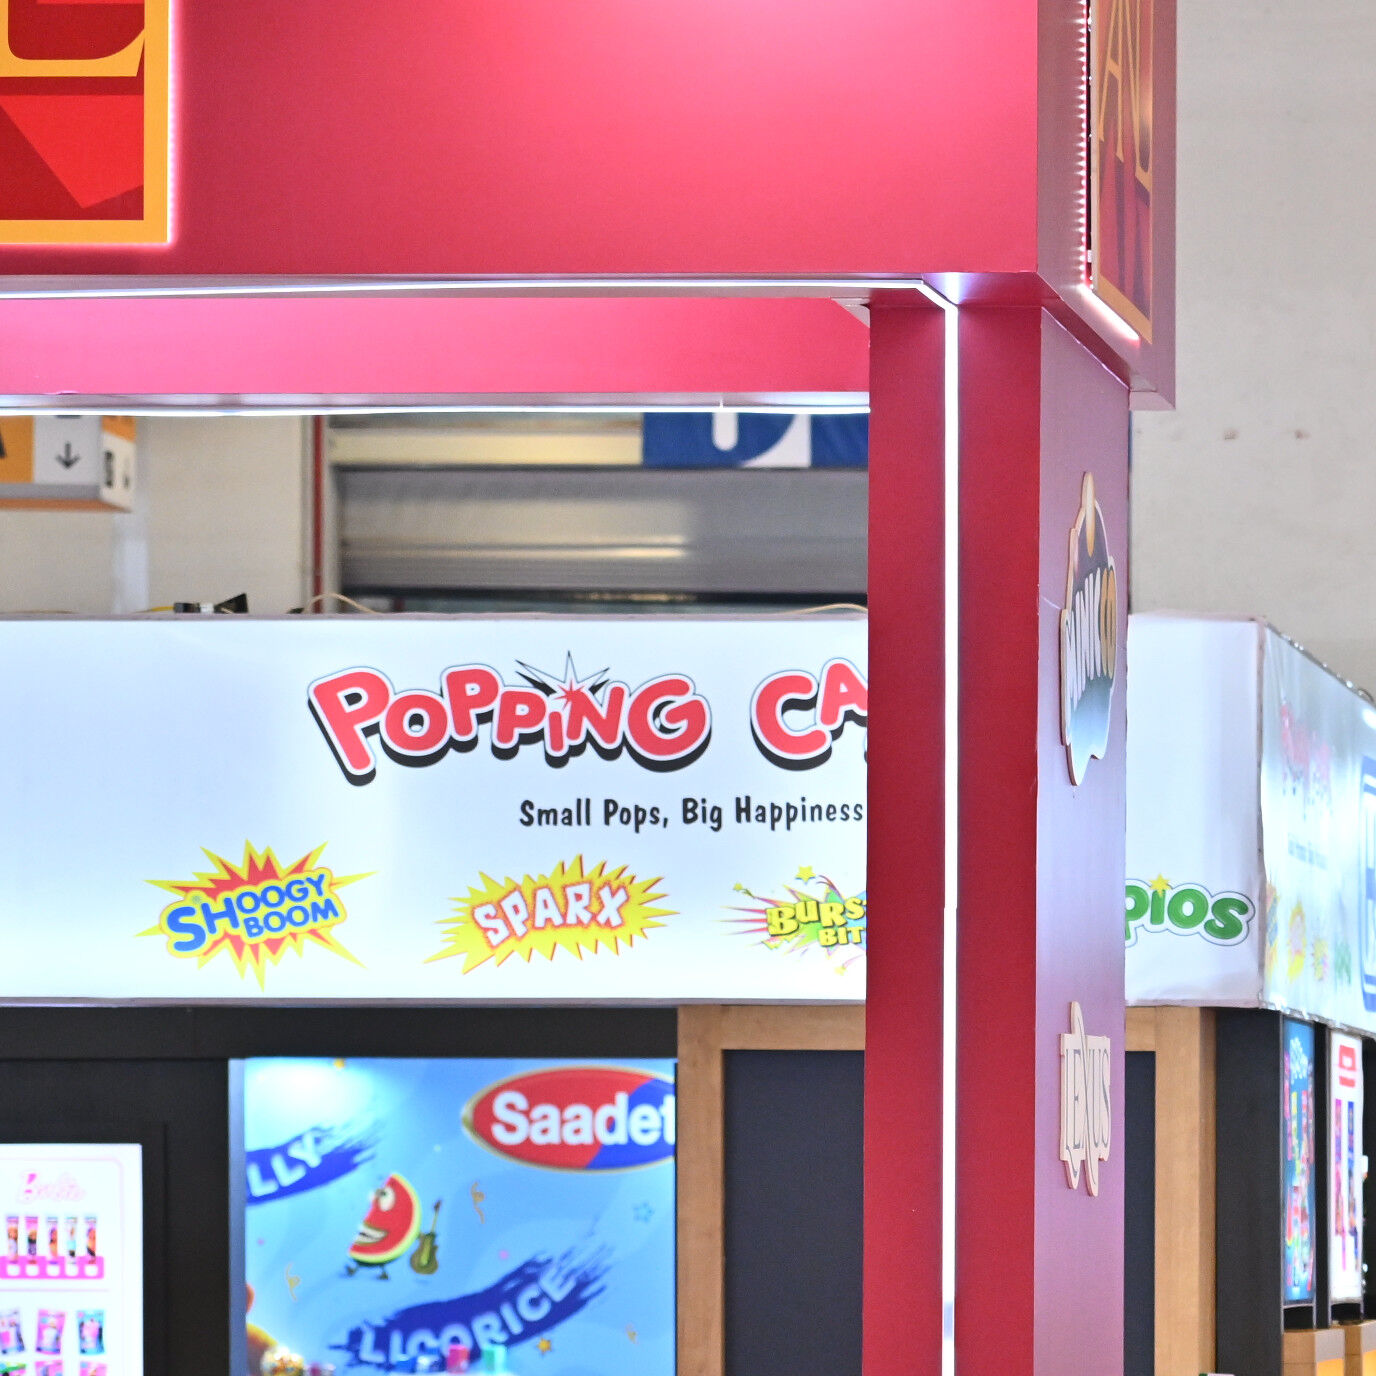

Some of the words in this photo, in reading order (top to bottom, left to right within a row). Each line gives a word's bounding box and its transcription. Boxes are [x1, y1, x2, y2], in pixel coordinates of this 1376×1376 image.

[308, 664, 712, 786] POPPING
[750, 658, 868, 771] CA
[519, 798, 591, 826] Small
[604, 798, 669, 834] Pops,
[682, 797, 723, 832] Big
[735, 795, 864, 831] Happiness
[166, 873, 326, 952] SHOOGY
[243, 898, 340, 939] BOOM
[472, 882, 629, 950] SPARX
[766, 896, 867, 937] BURS
[491, 1090, 675, 1146] Saadet
[1065, 1017, 1110, 1186] LEXUS
